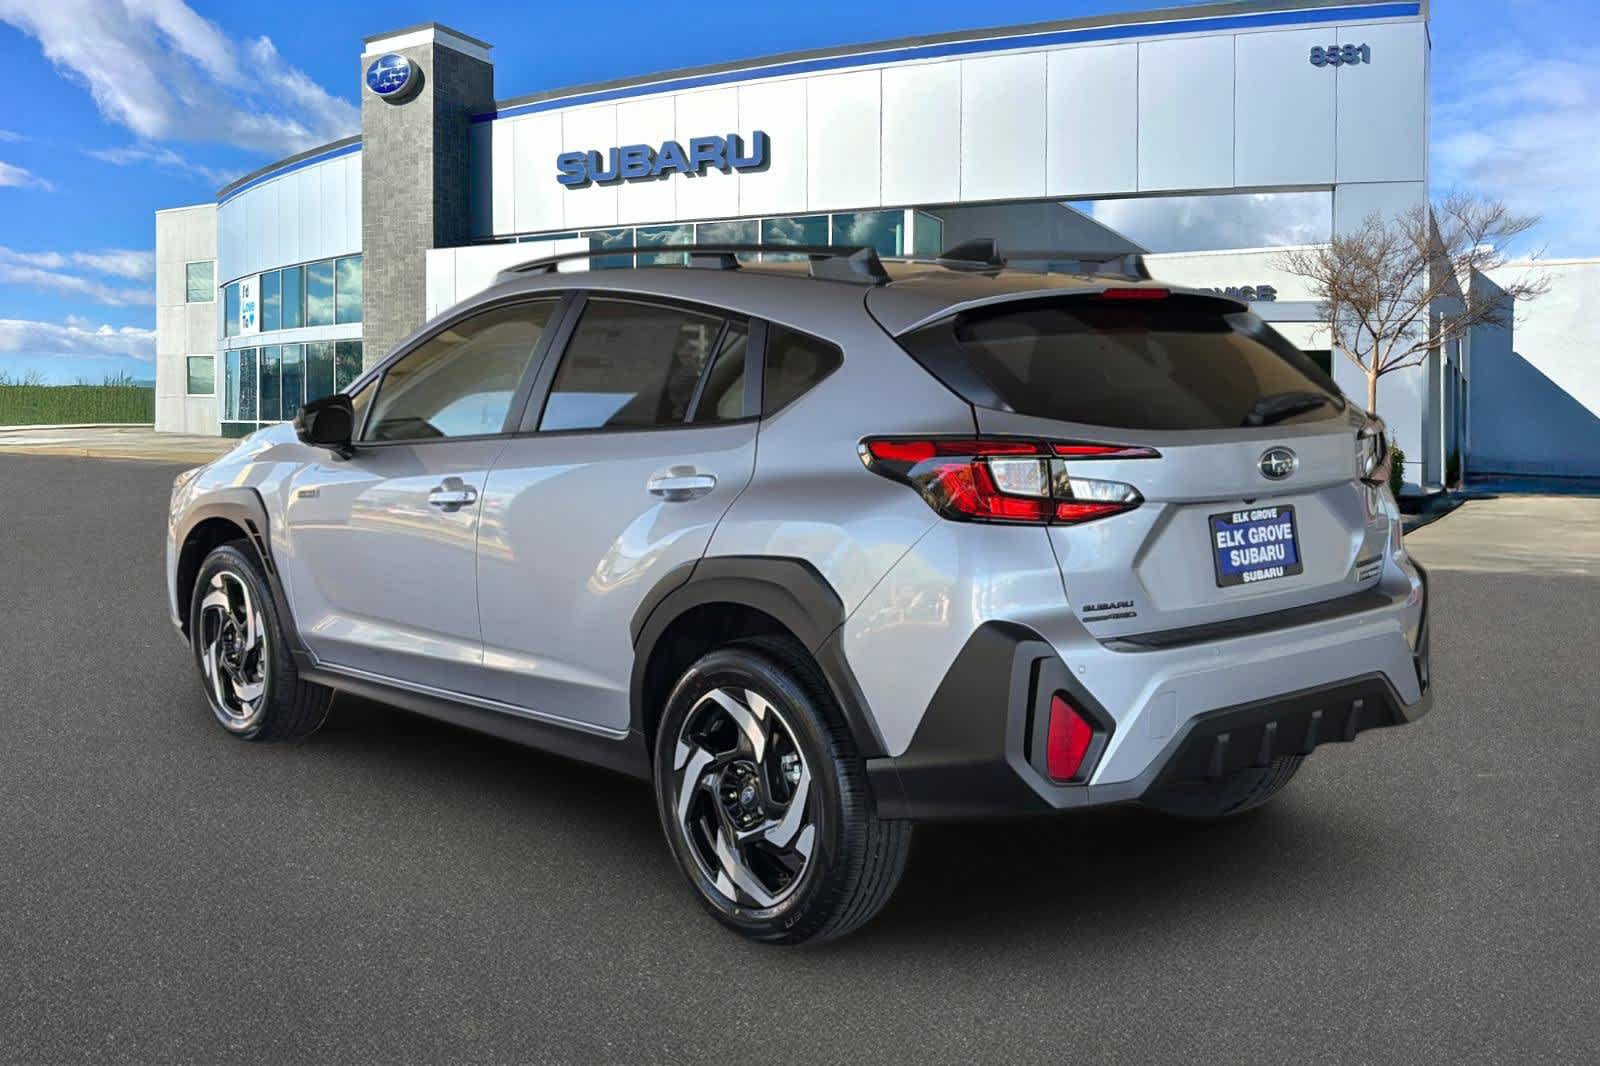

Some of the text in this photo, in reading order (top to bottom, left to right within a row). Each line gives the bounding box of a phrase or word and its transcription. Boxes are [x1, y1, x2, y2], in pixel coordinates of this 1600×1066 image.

[556, 130, 771, 190] SUBARU
[1232, 508, 1277, 524] ELK GROVE
[1216, 523, 1292, 549] ELK GROVE
[1230, 543, 1285, 567] SUBARU
[1242, 566, 1284, 582] SUBARU
